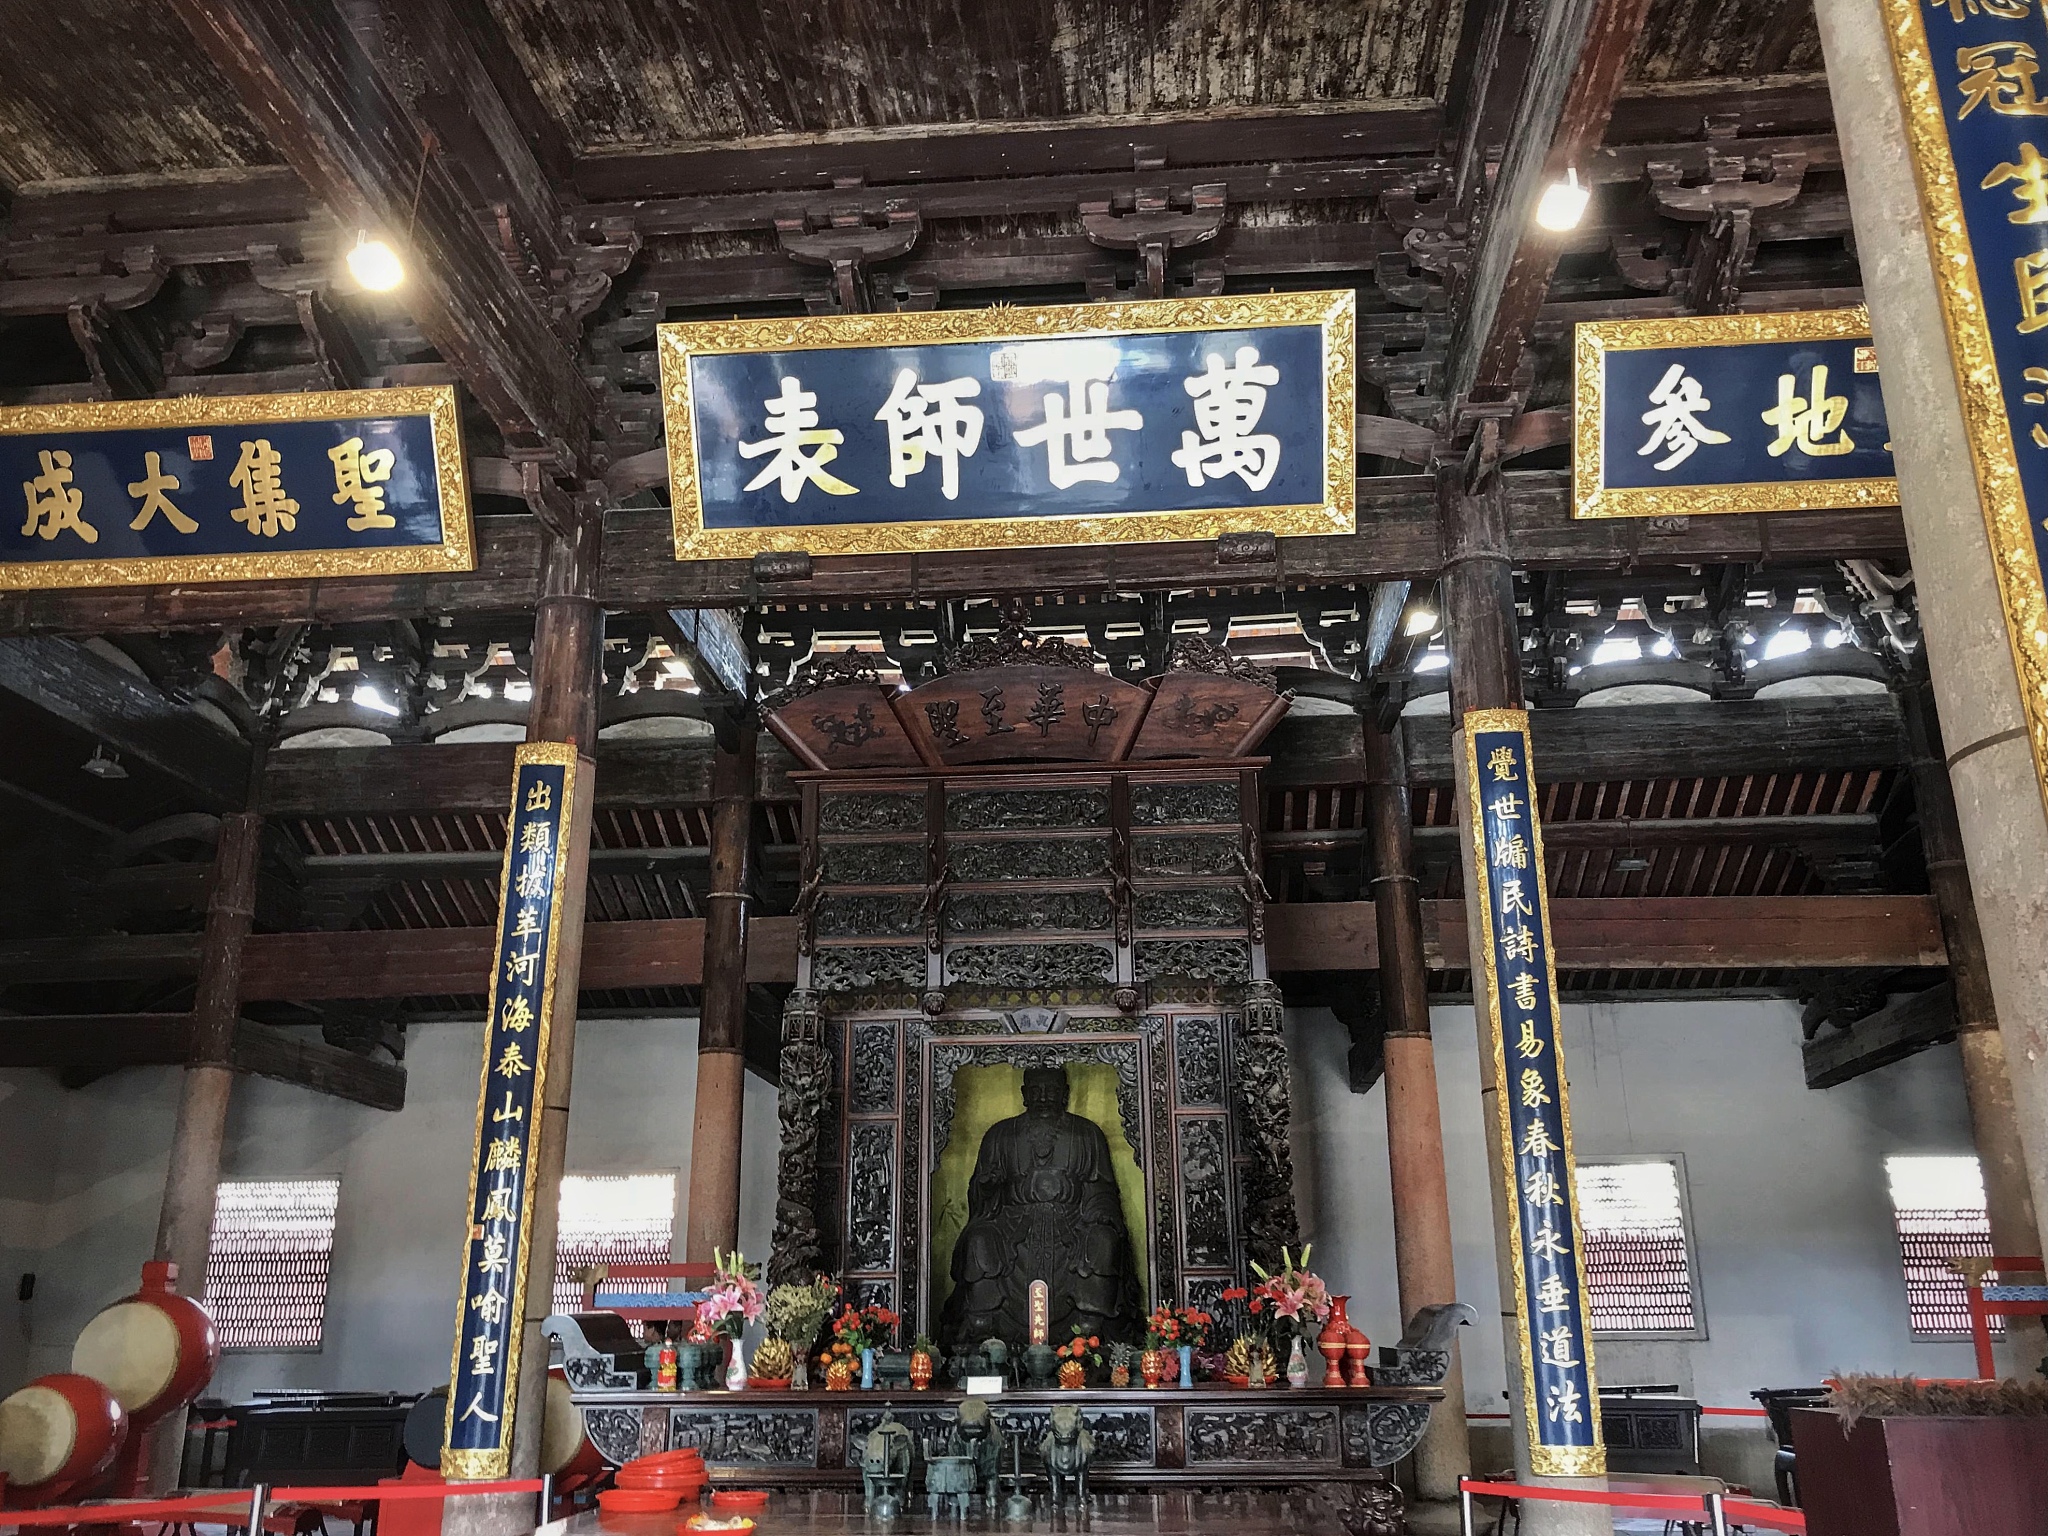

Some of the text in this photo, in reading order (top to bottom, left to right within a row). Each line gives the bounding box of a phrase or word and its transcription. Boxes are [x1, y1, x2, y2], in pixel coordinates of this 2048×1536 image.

[738, 345, 1280, 503] 萬世師表
[22, 437, 396, 544] 聖集大成
[925, 683, 1118, 747] 中華至聖
[460, 780, 551, 1423] 出類拔萃河海泰山麟鳳莫喻聖人
